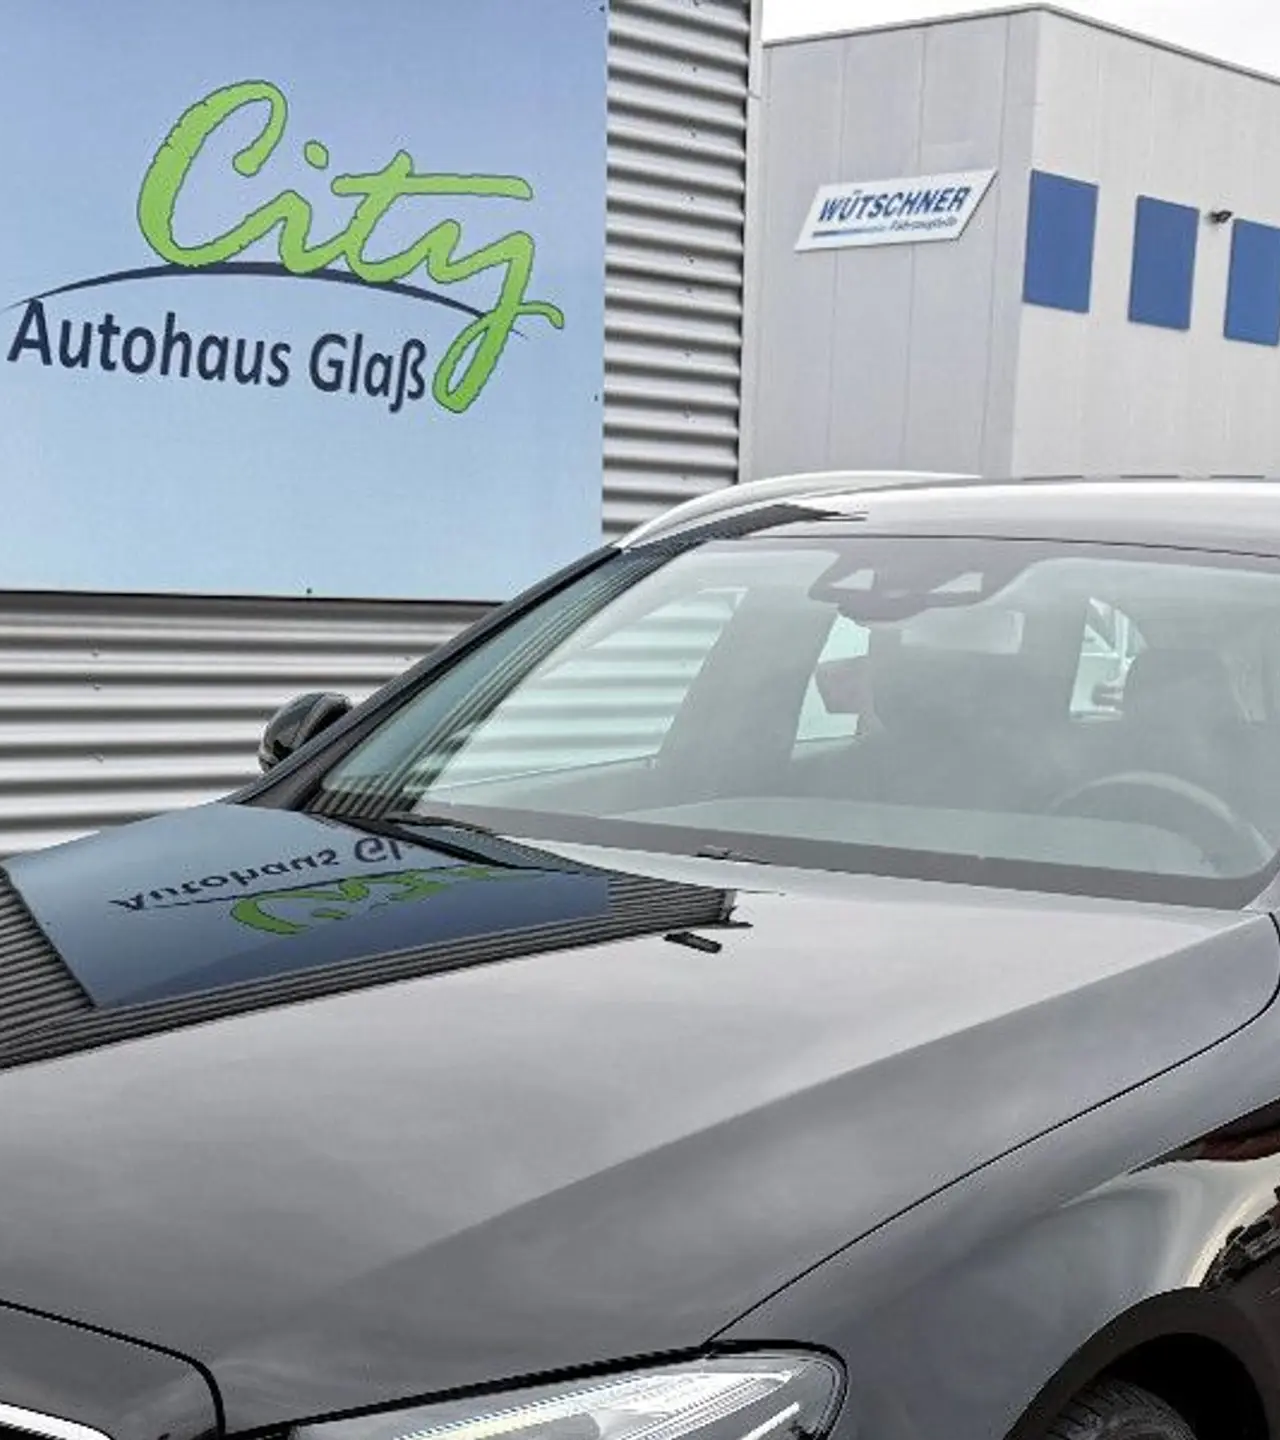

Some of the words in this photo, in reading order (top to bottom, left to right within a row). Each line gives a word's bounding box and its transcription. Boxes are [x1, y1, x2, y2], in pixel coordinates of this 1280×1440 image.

[137, 79, 564, 414] City
[818, 186, 971, 222] WÜTSCHNER
[7, 300, 290, 387] Autohaus
[309, 333, 427, 414] Glaß
